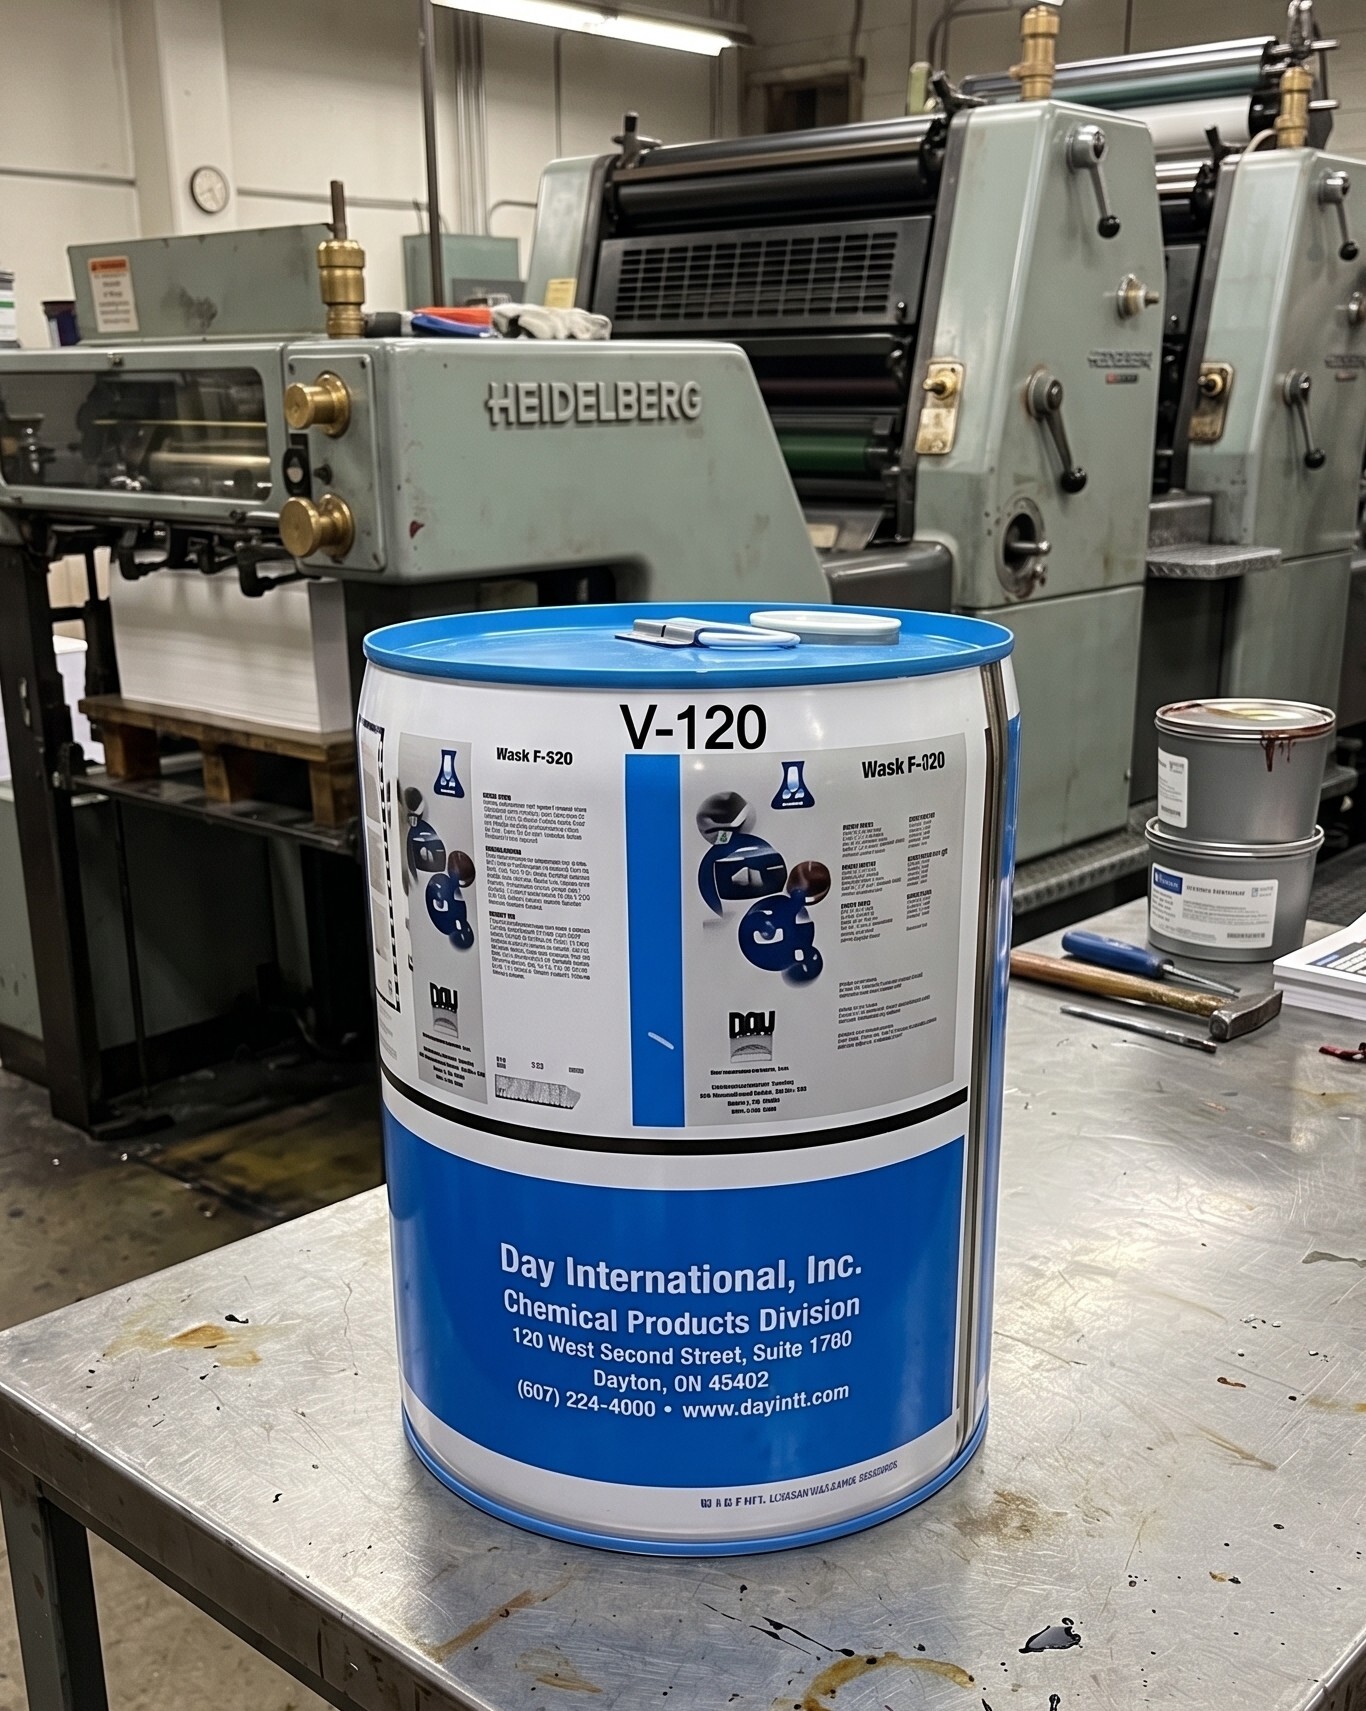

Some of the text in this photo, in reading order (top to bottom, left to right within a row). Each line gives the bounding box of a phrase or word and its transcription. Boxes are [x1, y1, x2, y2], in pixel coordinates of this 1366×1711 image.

[486, 381, 702, 426] HEIDELBERG
[619, 704, 767, 750] V-120
[496, 747, 530, 763] Wask
[861, 757, 905, 779] Wask
[500, 1242, 862, 1294] Day International, Inc.
[504, 1288, 861, 1336] Chemical Products Division
[512, 1326, 544, 1349] 120
[548, 1334, 595, 1359] West
[600, 1342, 674, 1365] Second
[680, 1346, 747, 1366] Street,
[753, 1341, 803, 1362] Suite
[517, 1379, 850, 1418] (607) 224-4000 www.dayintt.com
[593, 1369, 769, 1395] Dayton, ON 45402
